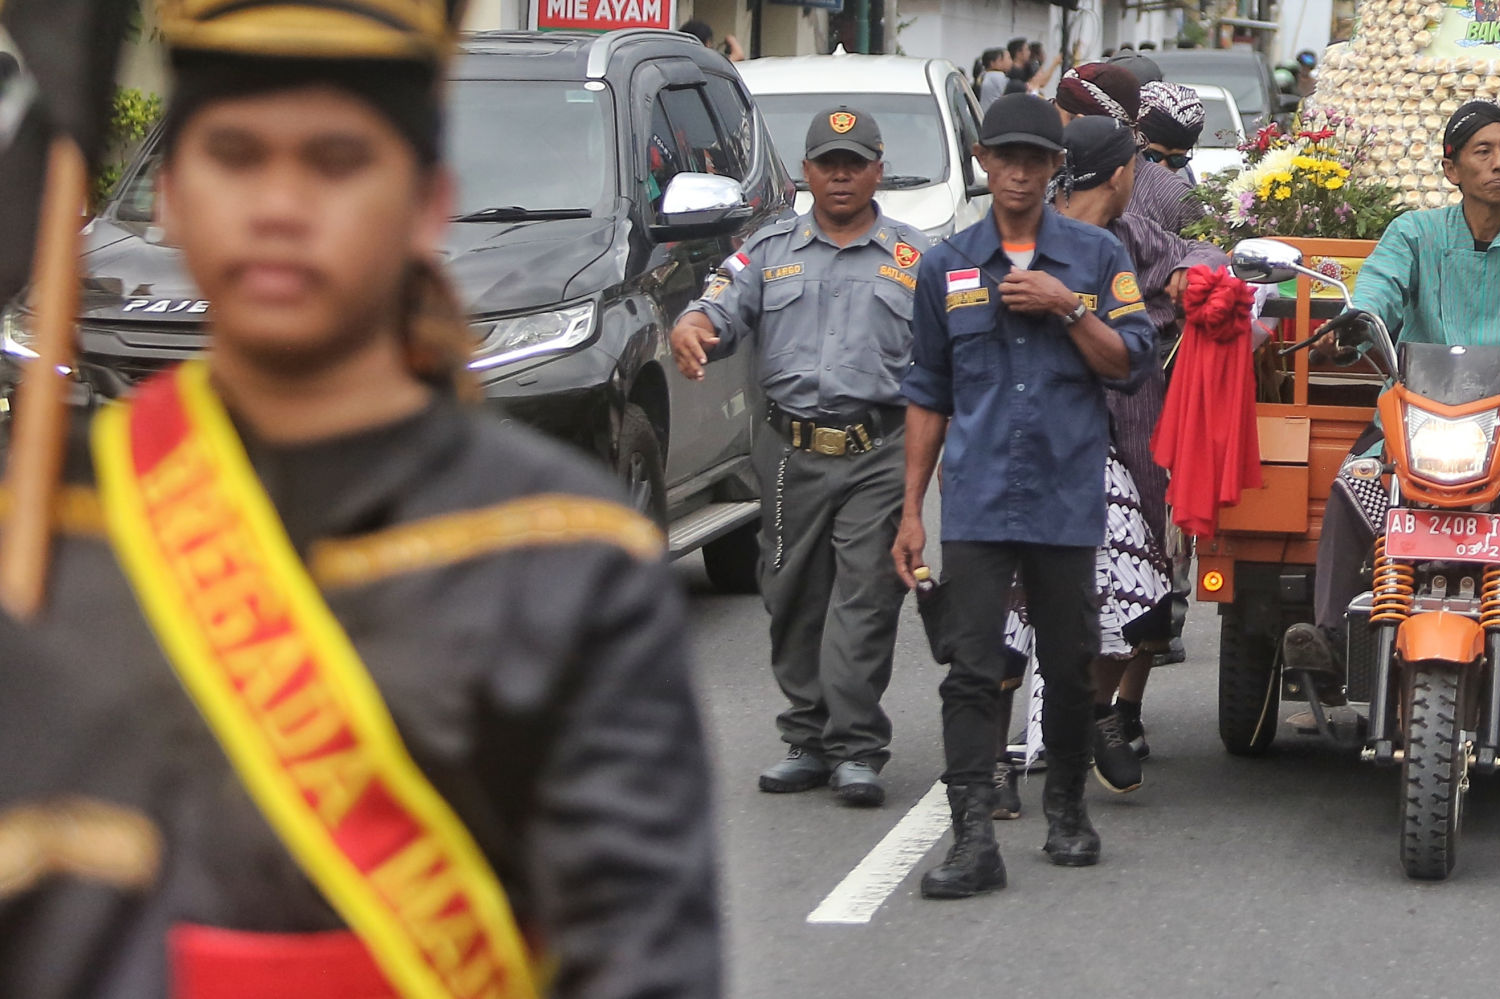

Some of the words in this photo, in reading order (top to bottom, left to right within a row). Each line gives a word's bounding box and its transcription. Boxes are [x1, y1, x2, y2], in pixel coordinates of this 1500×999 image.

[122, 298, 212, 314] PAJE
[1390, 513, 1416, 534] AB
[1429, 515, 1478, 536] 2408
